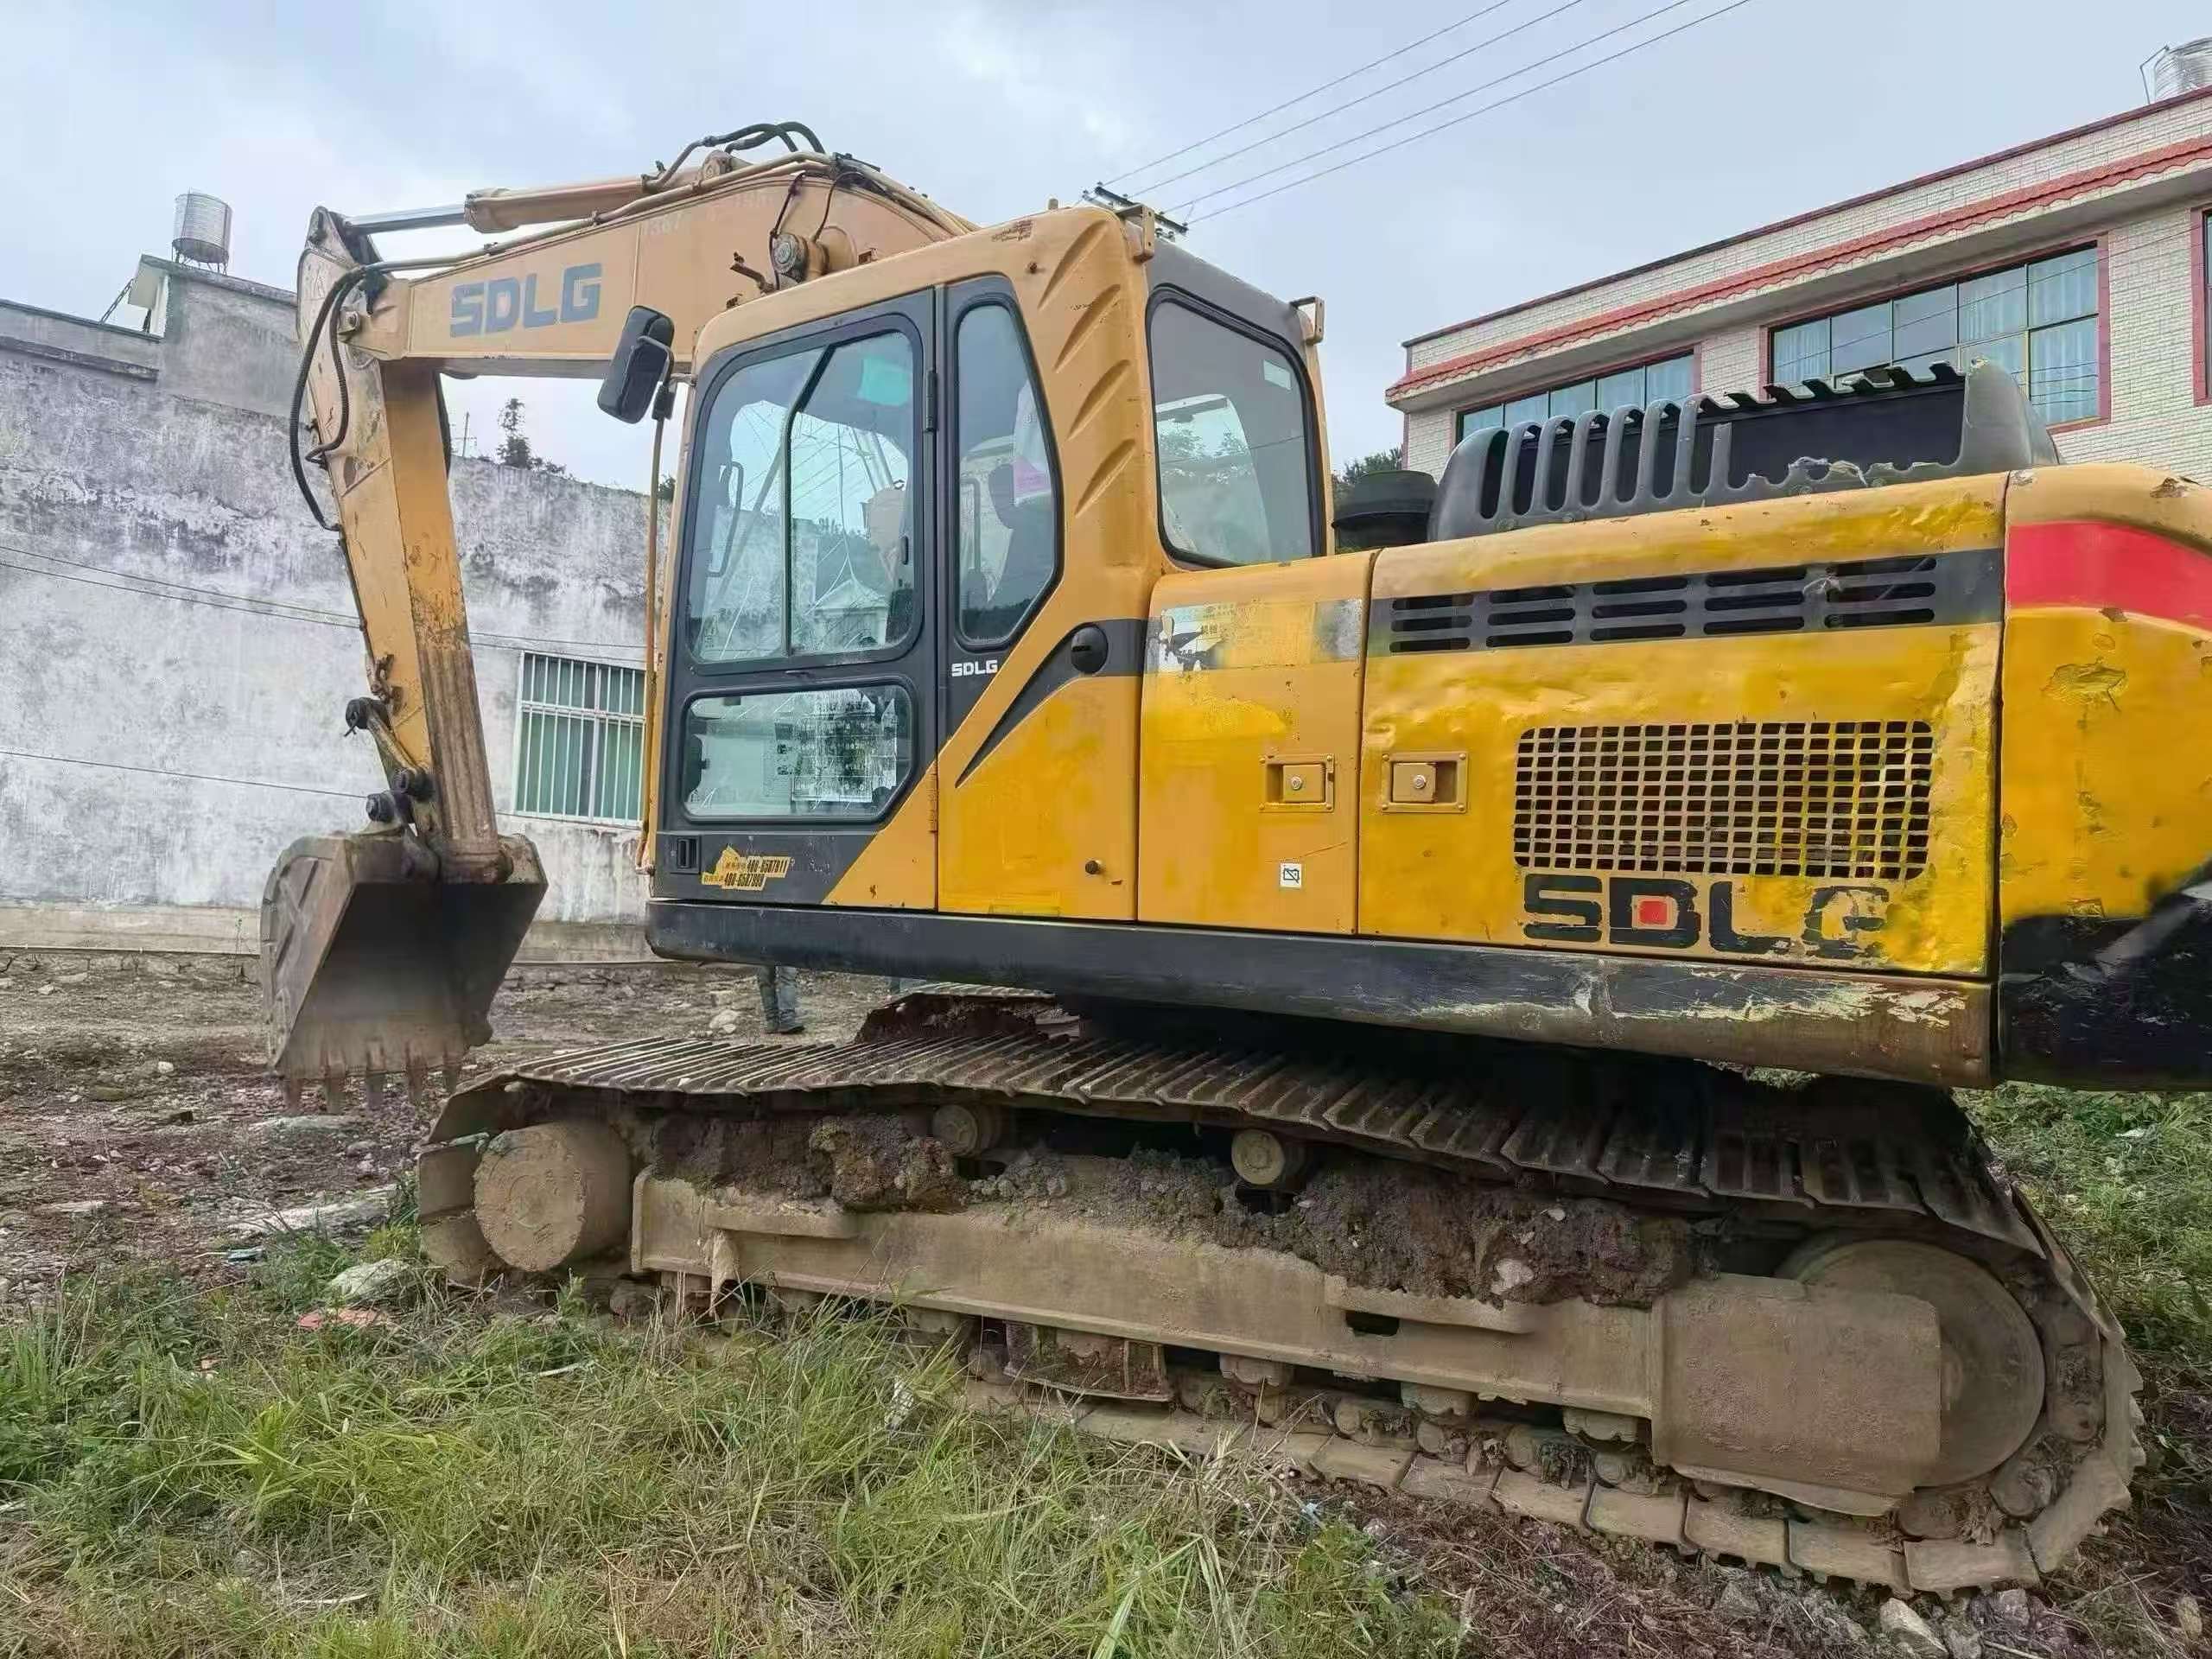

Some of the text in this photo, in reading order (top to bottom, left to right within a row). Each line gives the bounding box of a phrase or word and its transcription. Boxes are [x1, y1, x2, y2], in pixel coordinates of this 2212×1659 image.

[450, 263, 601, 338] SDLG
[951, 659, 998, 677] SDLG
[1523, 873, 1890, 959] SDLG
